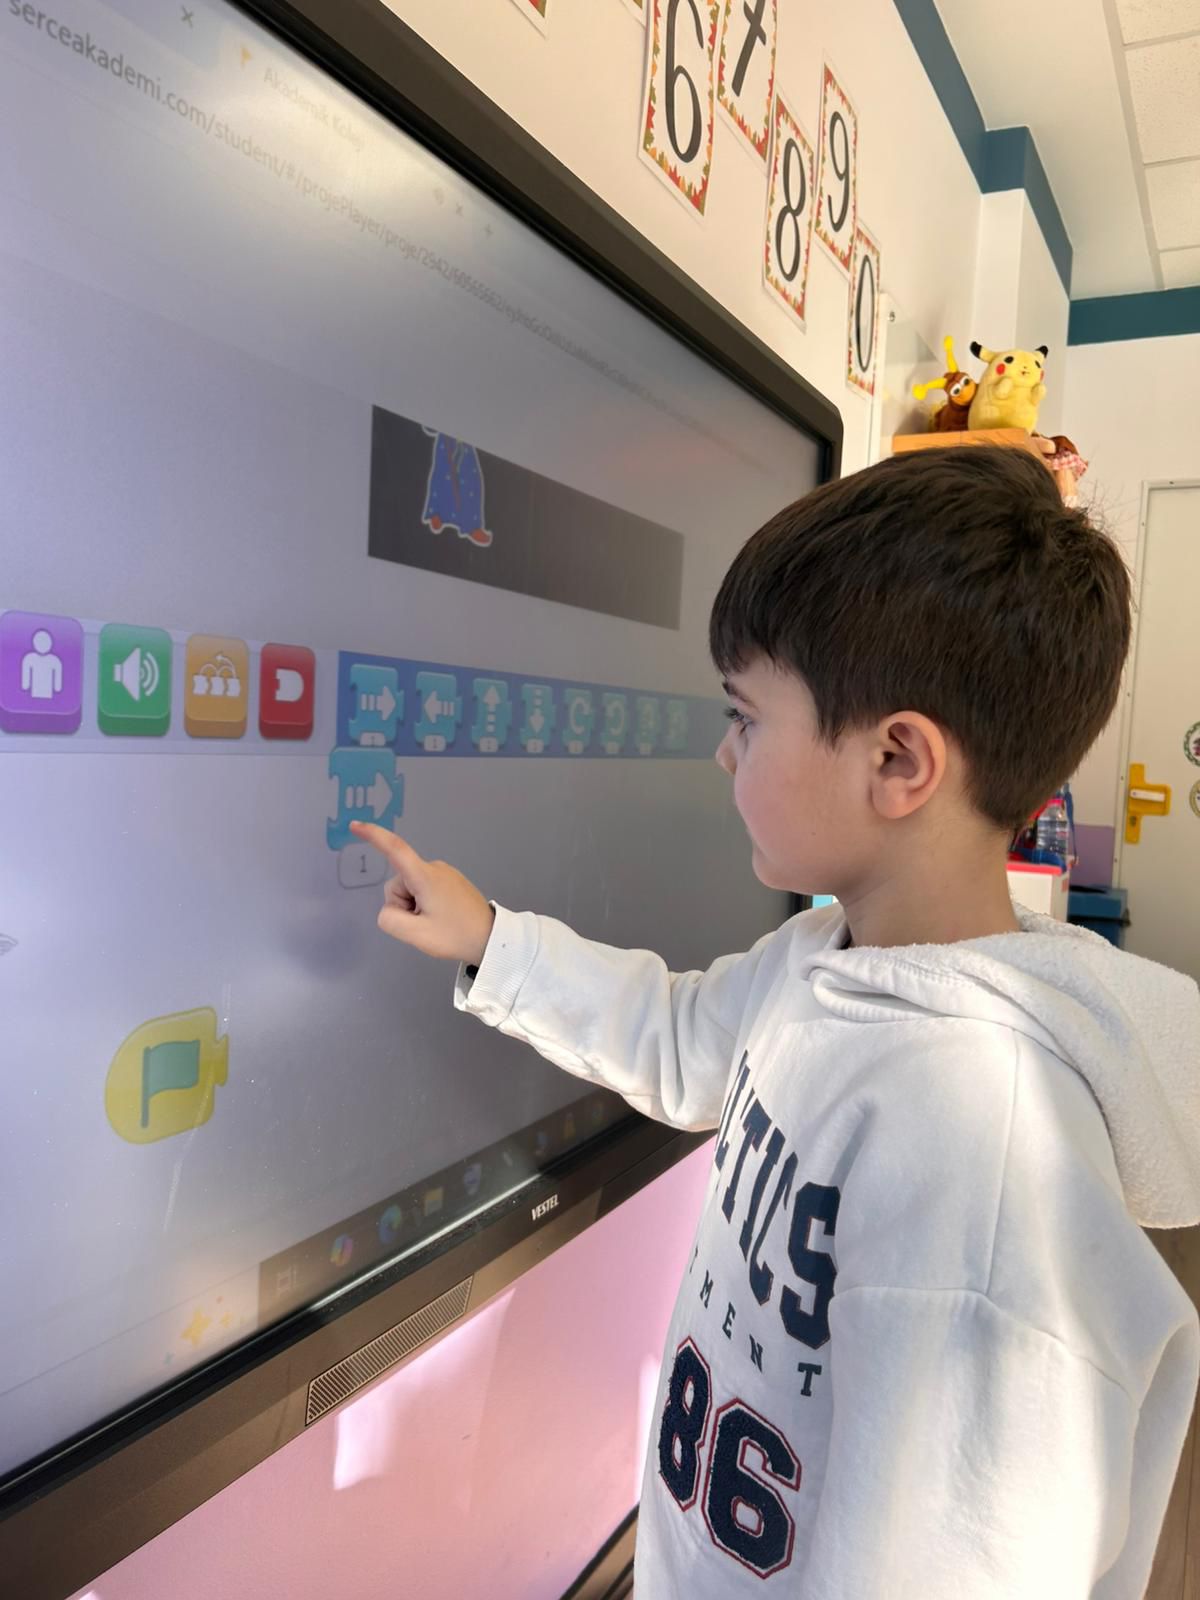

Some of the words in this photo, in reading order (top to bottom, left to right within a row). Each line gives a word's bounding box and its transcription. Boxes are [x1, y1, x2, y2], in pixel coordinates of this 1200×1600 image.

[665, 0, 704, 163] 6
[775, 138, 806, 282] 8
[828, 111, 849, 232] 9
[855, 254, 875, 373] 0
[360, 854, 367, 873] 1
[531, 1194, 559, 1221] VESTEL
[658, 1335, 802, 1580] 86
